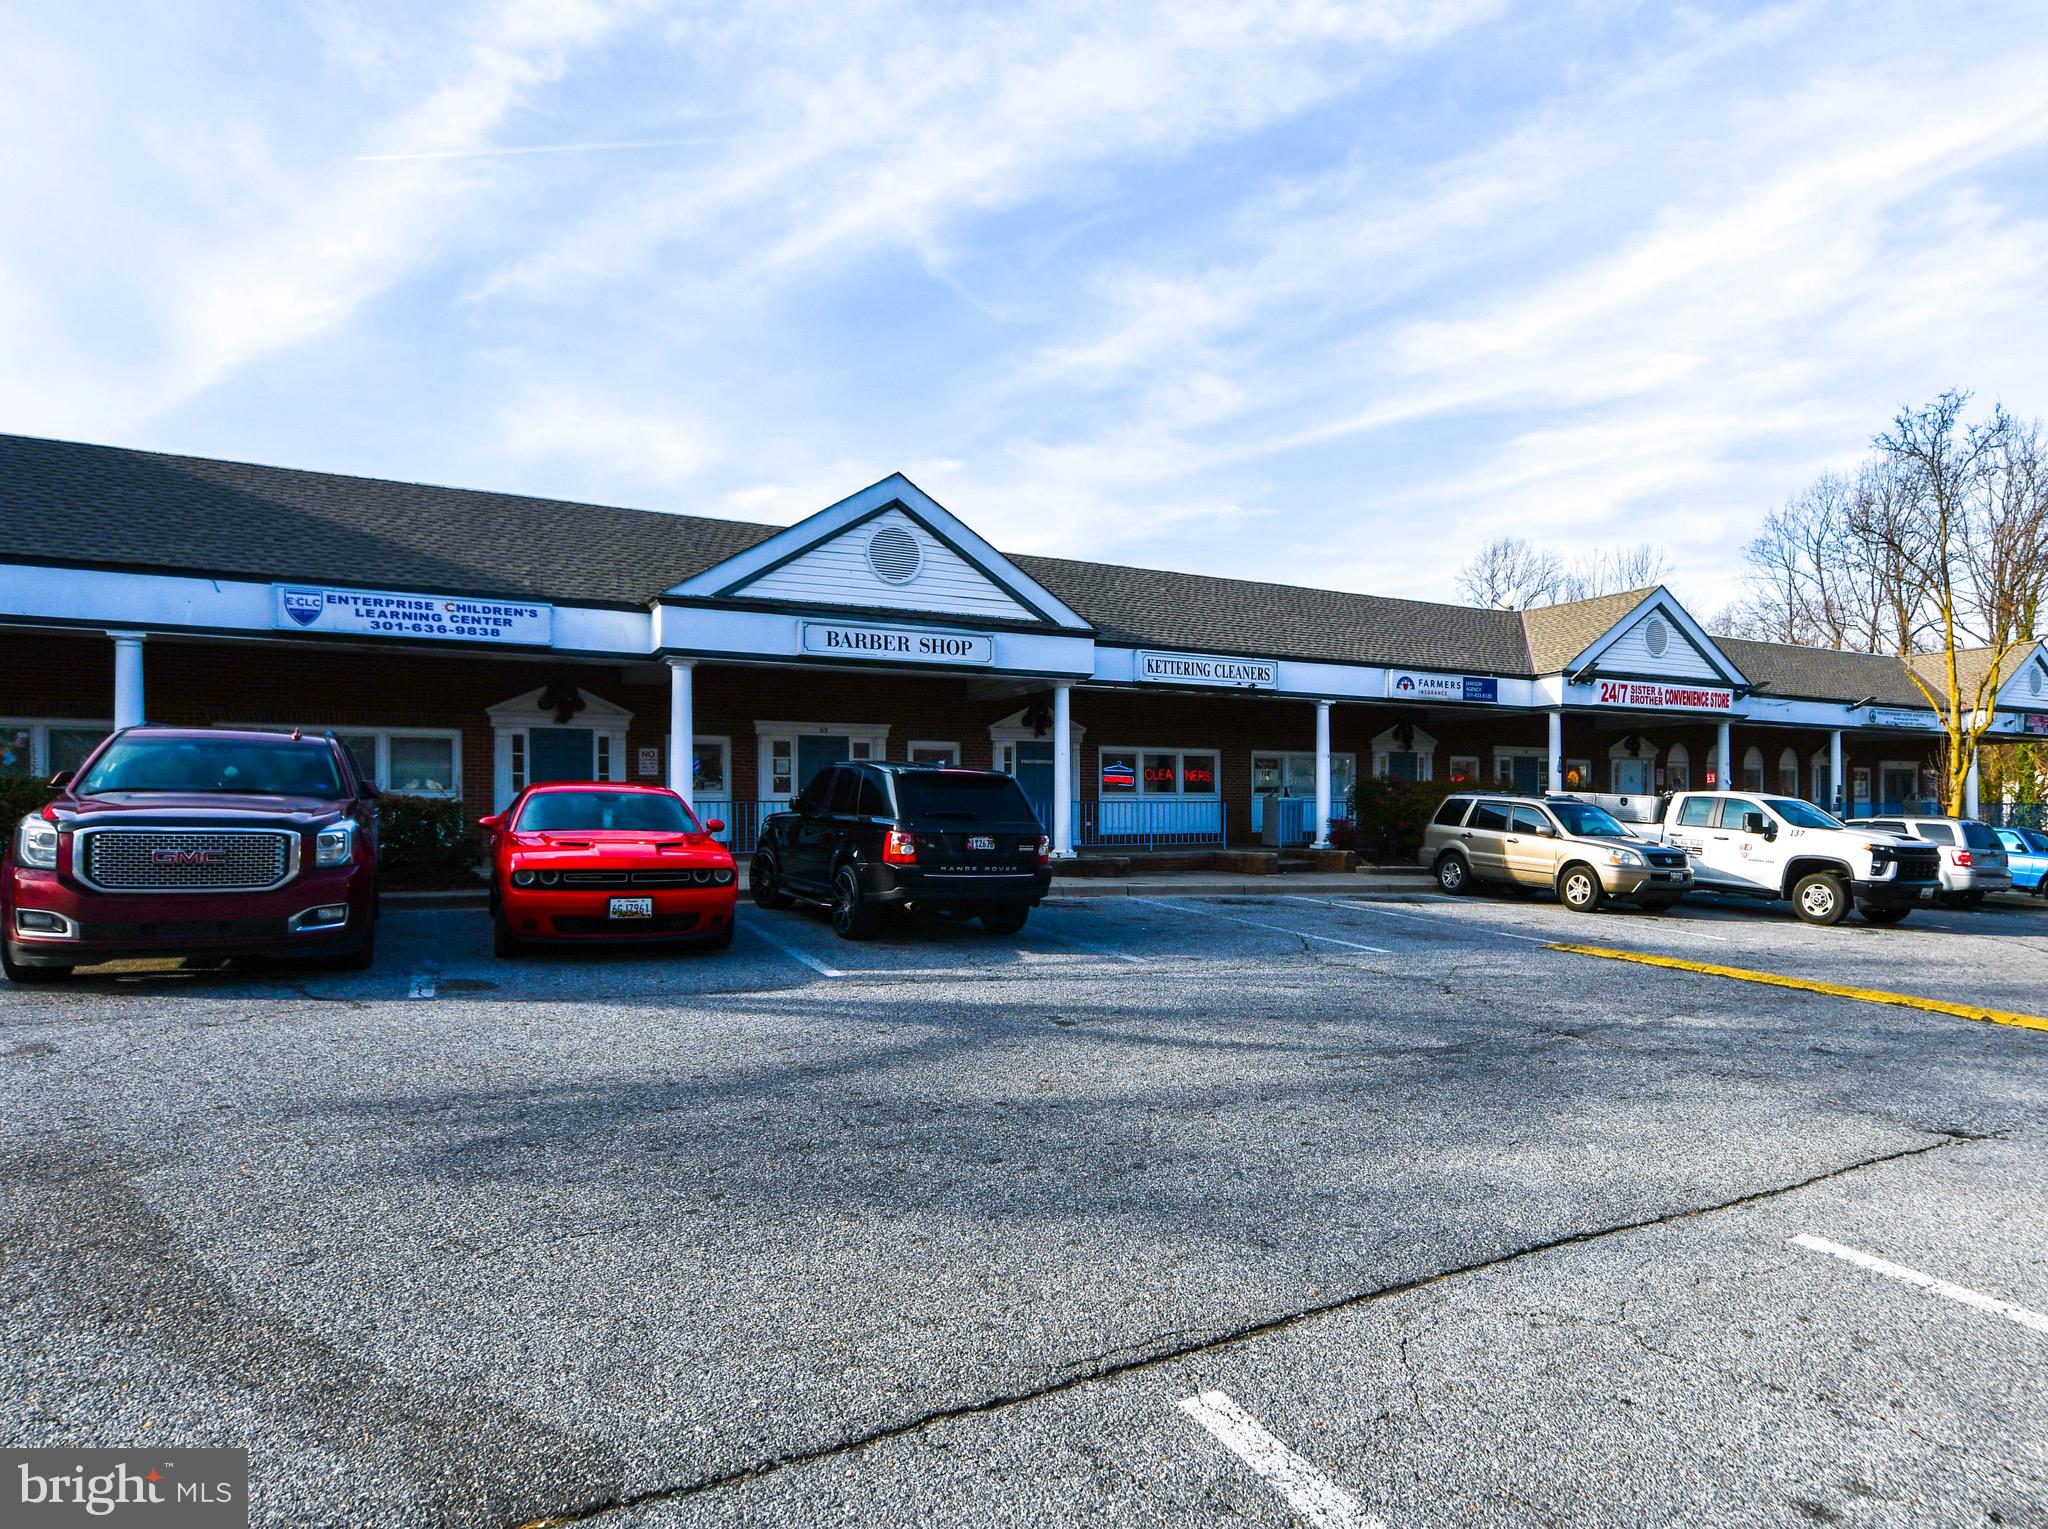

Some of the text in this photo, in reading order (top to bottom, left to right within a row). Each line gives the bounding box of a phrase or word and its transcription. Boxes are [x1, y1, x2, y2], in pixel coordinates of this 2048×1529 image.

[326, 594, 538, 618] ENTERPRISE CHILDREN'S
[355, 608, 513, 627] LEARNING CENTER
[370, 620, 501, 637] 301-636-9838
[825, 630, 973, 656] BARBER SHOP
[1147, 659, 1270, 681] KETTERING CLEANERS
[1418, 679, 1461, 689] FARMERS
[1630, 685, 1663, 696] SISTER &
[1600, 682, 1628, 704] 24/7
[1630, 695, 1663, 706] BROTHER
[1664, 689, 1730, 709] CONVENIENCE STORE
[641, 750, 655, 758] NO
[1790, 829, 1805, 837] 137
[151, 849, 226, 864] GMC
